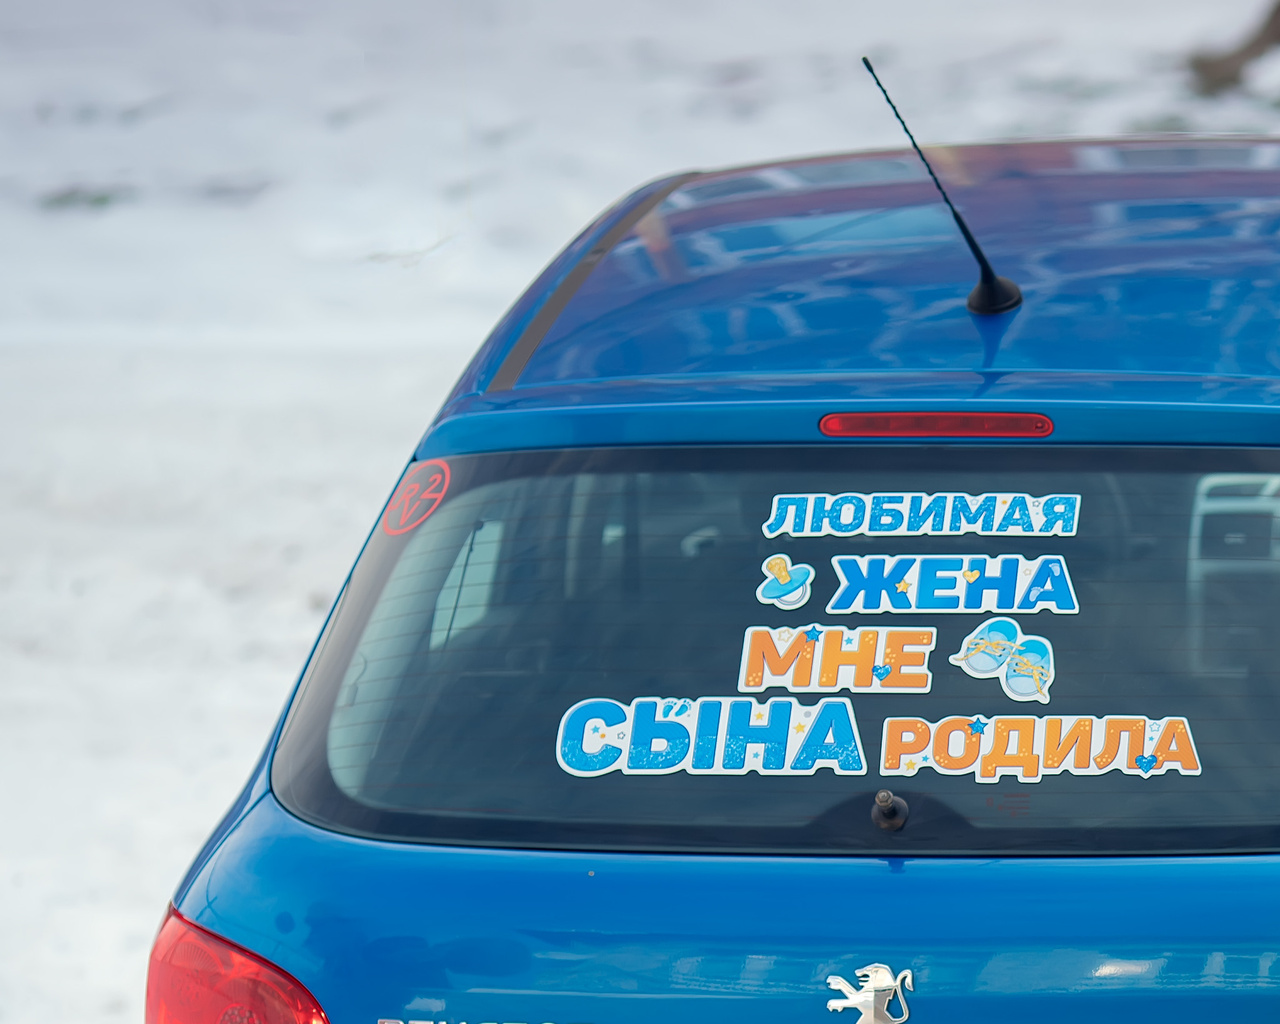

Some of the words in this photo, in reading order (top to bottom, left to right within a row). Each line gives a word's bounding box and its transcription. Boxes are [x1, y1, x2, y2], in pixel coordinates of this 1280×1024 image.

[766, 494, 1081, 535] ЛЮБИМАЯ
[830, 557, 1078, 611] ЖЕНА
[743, 629, 934, 689] МНЕ
[560, 699, 865, 773] СЫНА
[885, 717, 1200, 781] РОДИЛА
